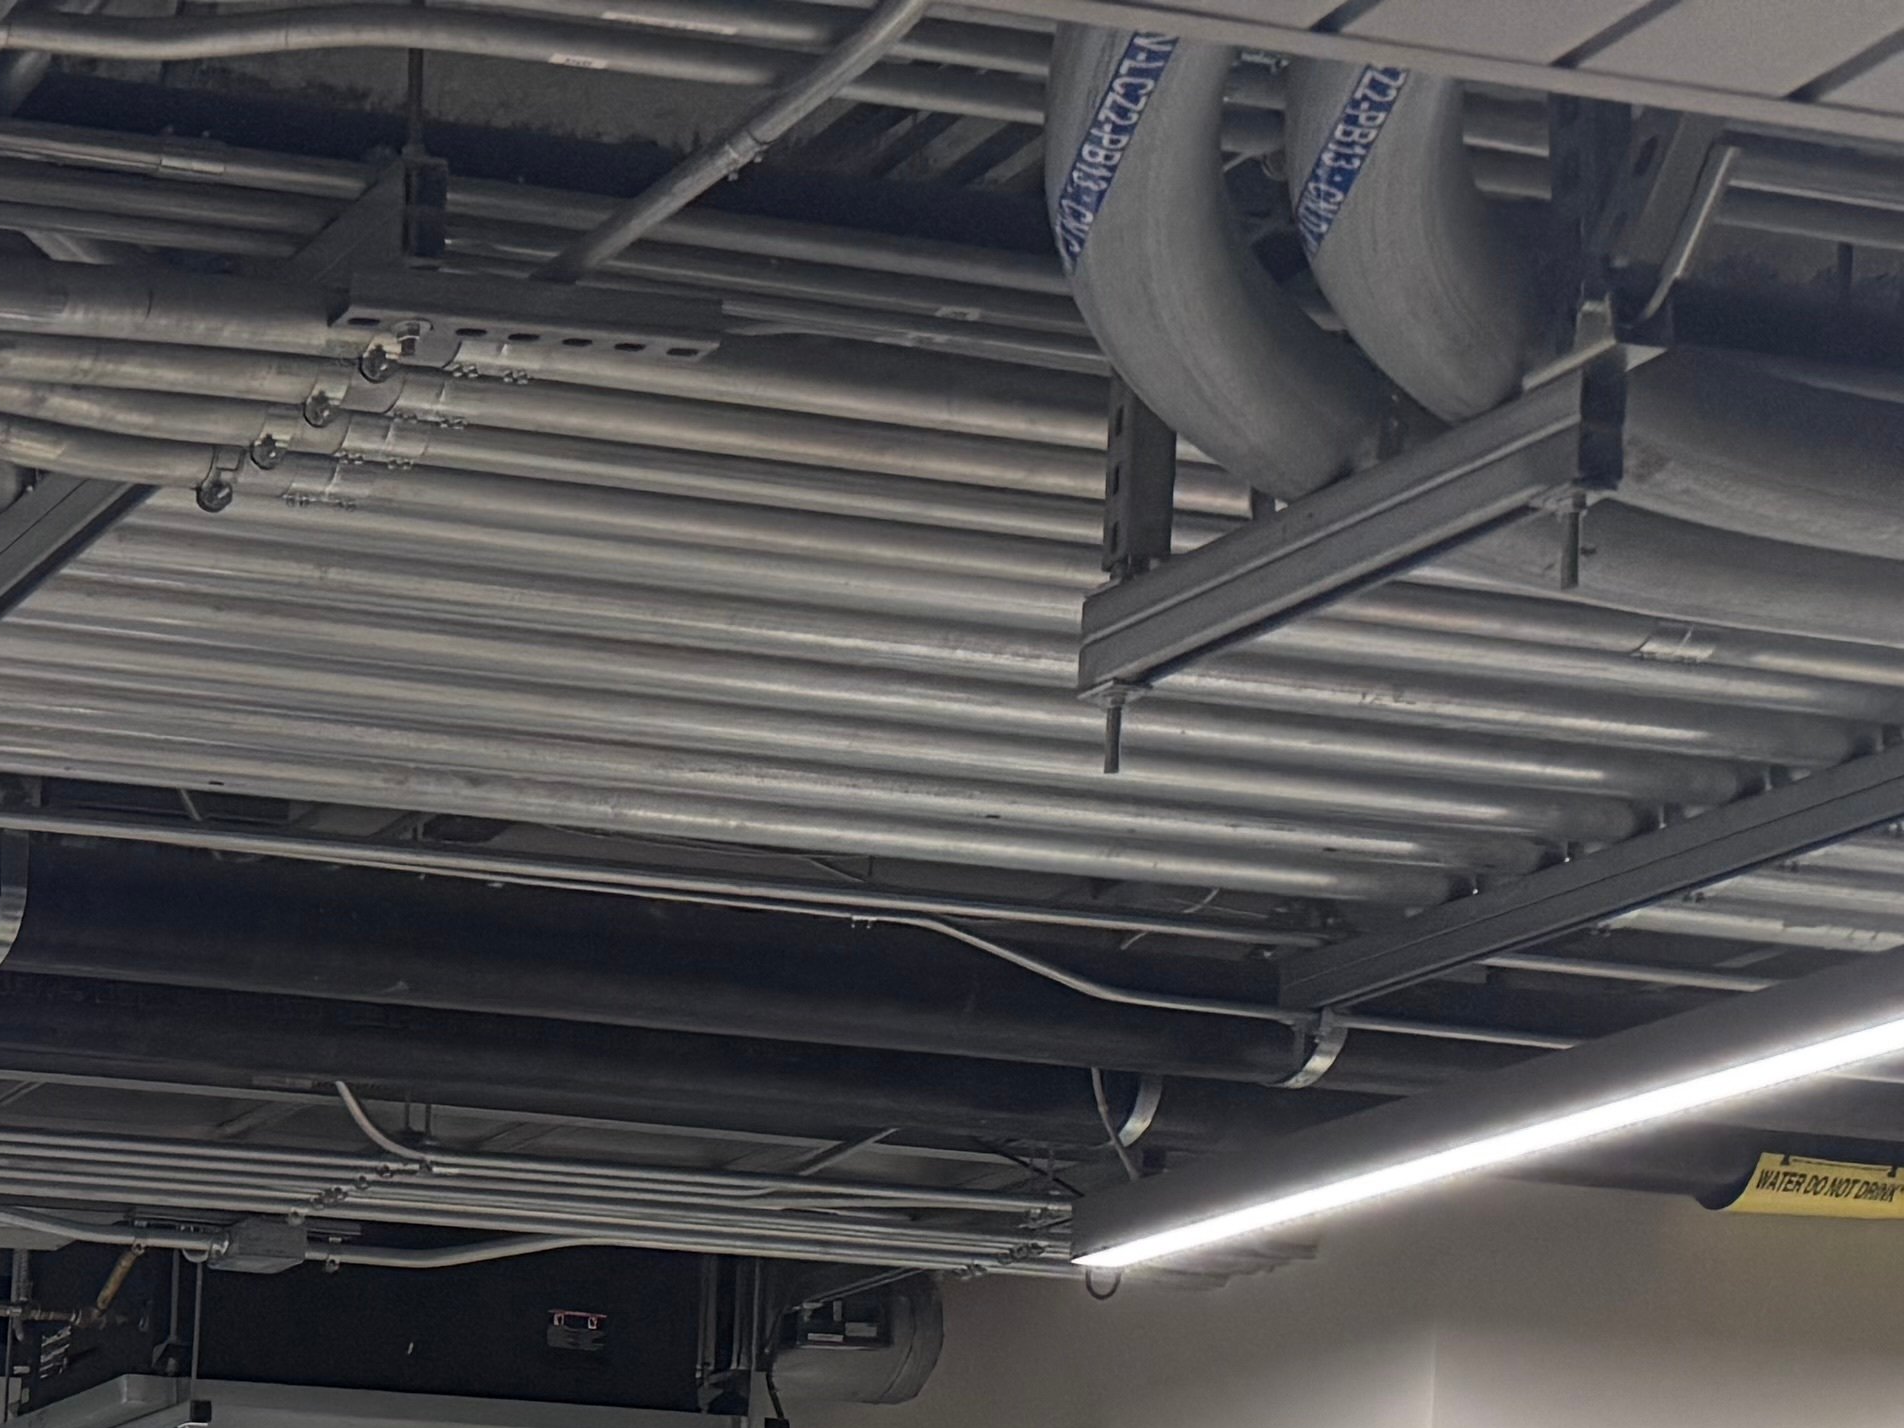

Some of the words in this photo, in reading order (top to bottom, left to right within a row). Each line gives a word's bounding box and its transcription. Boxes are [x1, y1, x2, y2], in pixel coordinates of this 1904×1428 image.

[1756, 1169, 1806, 1193] WATER
[1804, 1175, 1827, 1196] DO
[1824, 1178, 1861, 1199] NOT
